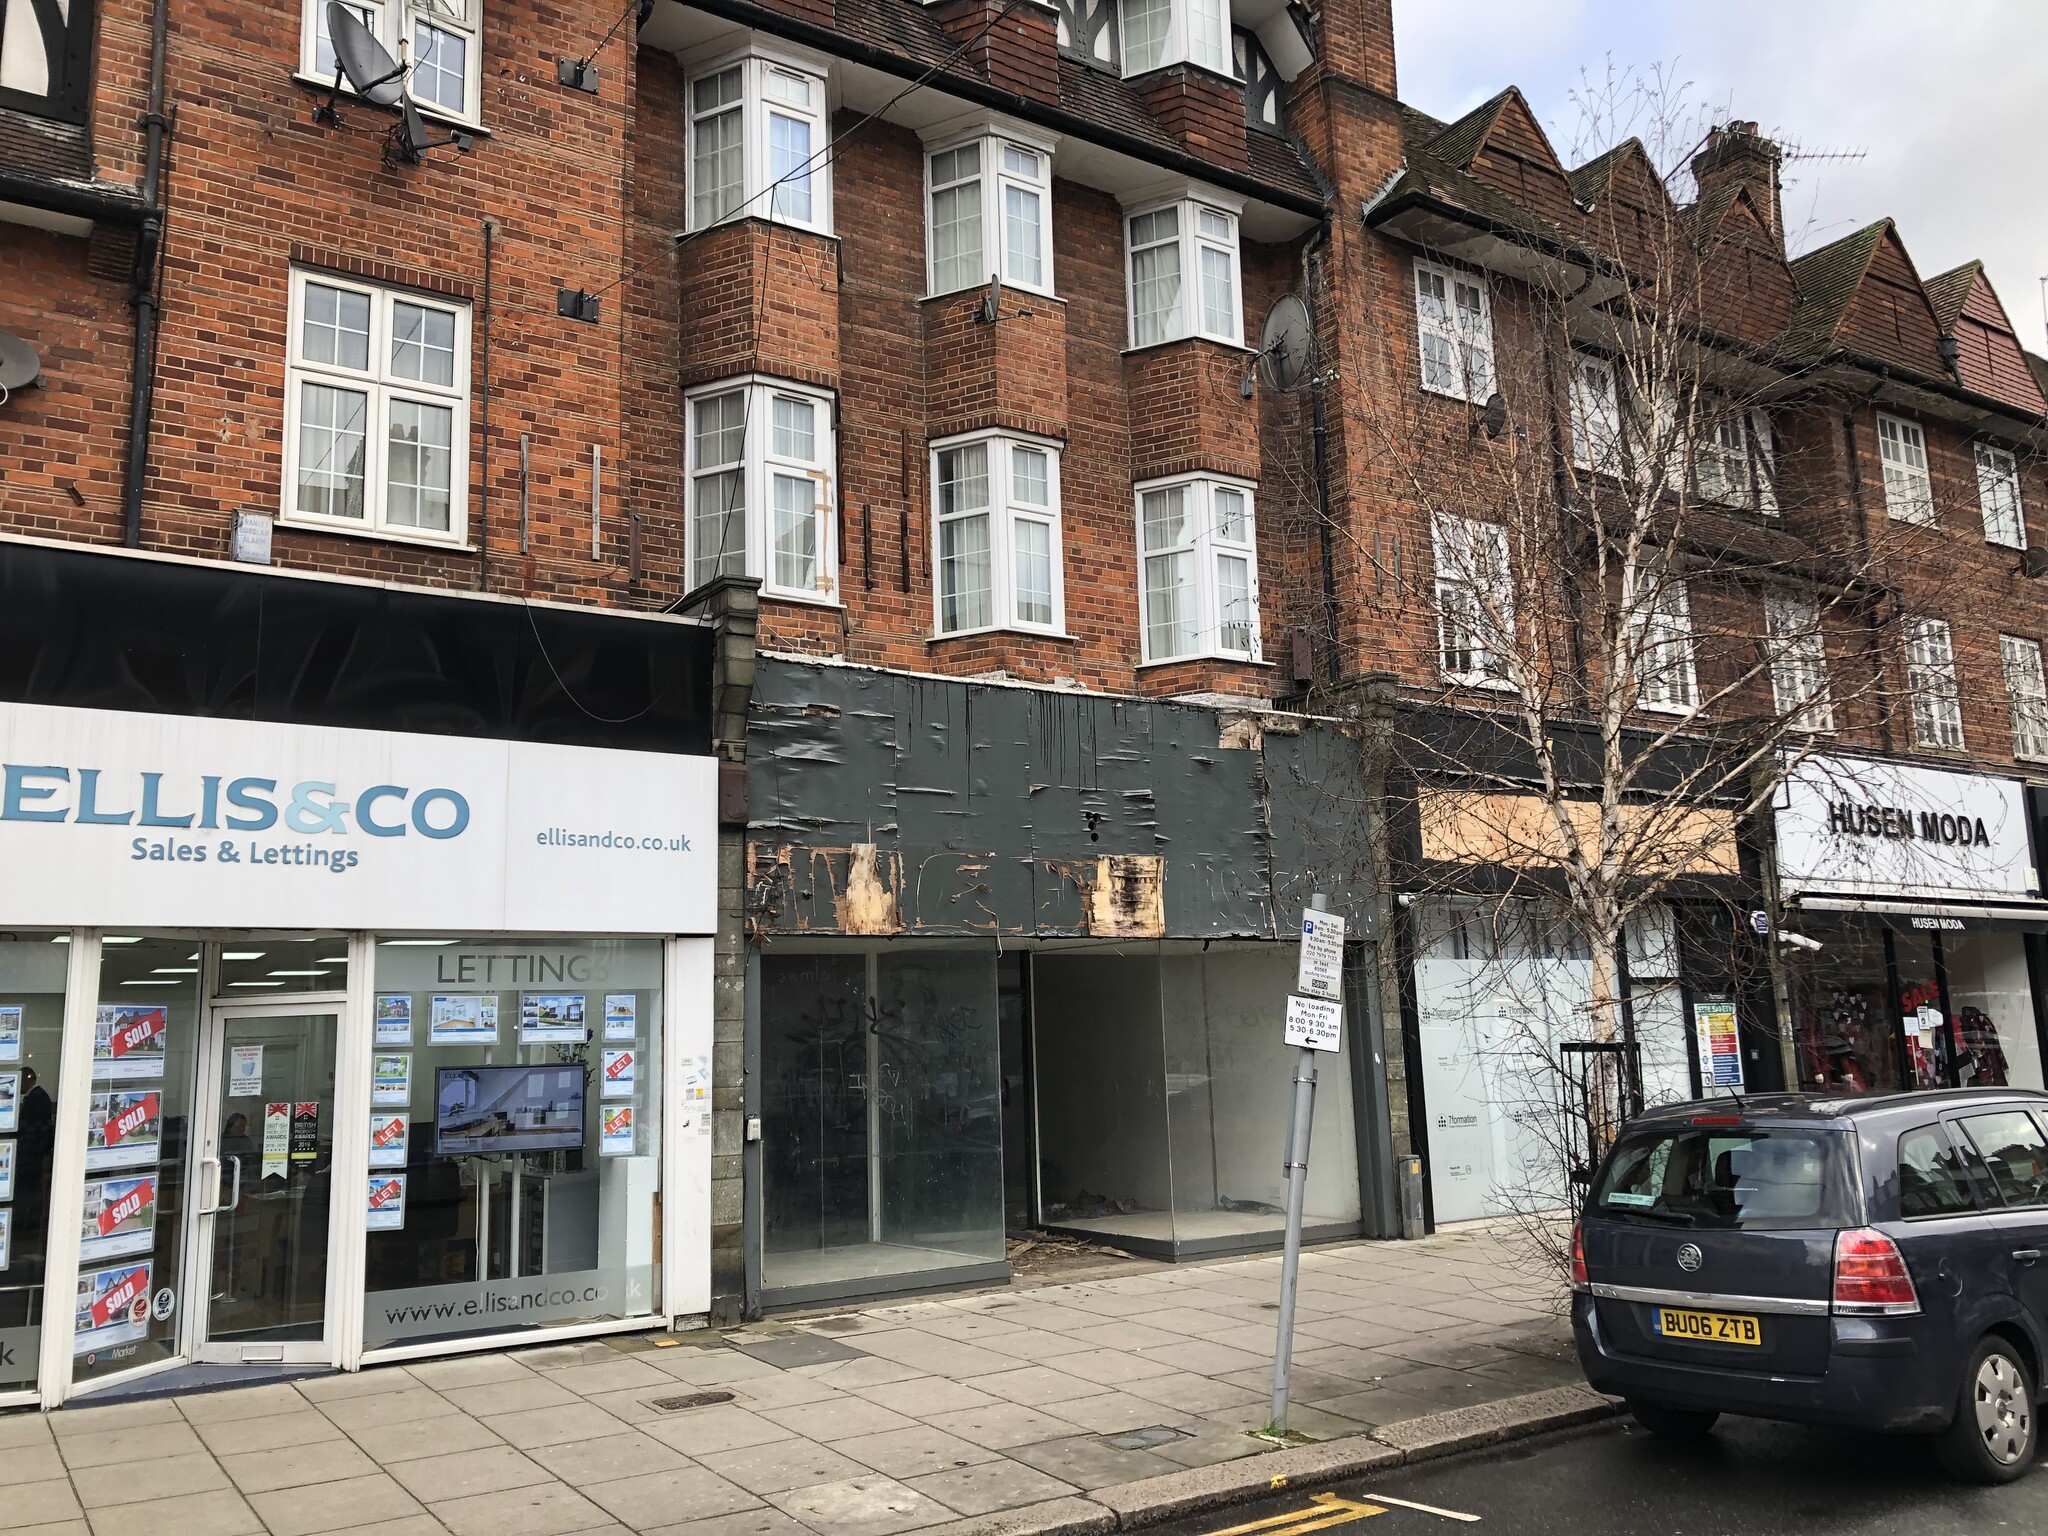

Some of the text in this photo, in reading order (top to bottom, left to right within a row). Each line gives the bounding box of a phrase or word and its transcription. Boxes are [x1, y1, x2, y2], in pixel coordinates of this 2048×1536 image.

[242, 536, 266, 545] ALARM
[0, 763, 470, 839] ELLIS&CO
[1829, 801, 1990, 847] HUSEN MODA
[536, 827, 691, 852] ellisandco.co.uk
[131, 837, 359, 873] Sales & Lettings
[1912, 917, 1965, 930] HUSEN MODA
[1319, 932, 1335, 940] Sunday
[1307, 943, 1316, 951] Pay
[1304, 970, 1320, 978] quoting
[1311, 987, 1321, 996] stay
[1902, 977, 1941, 1014] SALE
[1295, 1000, 1335, 1014] No loading
[124, 1020, 152, 1049] SOLD
[612, 1057, 627, 1073] LET
[118, 1106, 146, 1136] SOLD
[610, 1114, 626, 1131] LET
[1448, 1115, 1478, 1124] 7formation
[380, 1123, 400, 1143] LET
[376, 1186, 394, 1203] LET
[111, 1193, 141, 1224] SOLD
[105, 1281, 134, 1315] SOLD
[1664, 1313, 1756, 1341] BU06 ZTB
